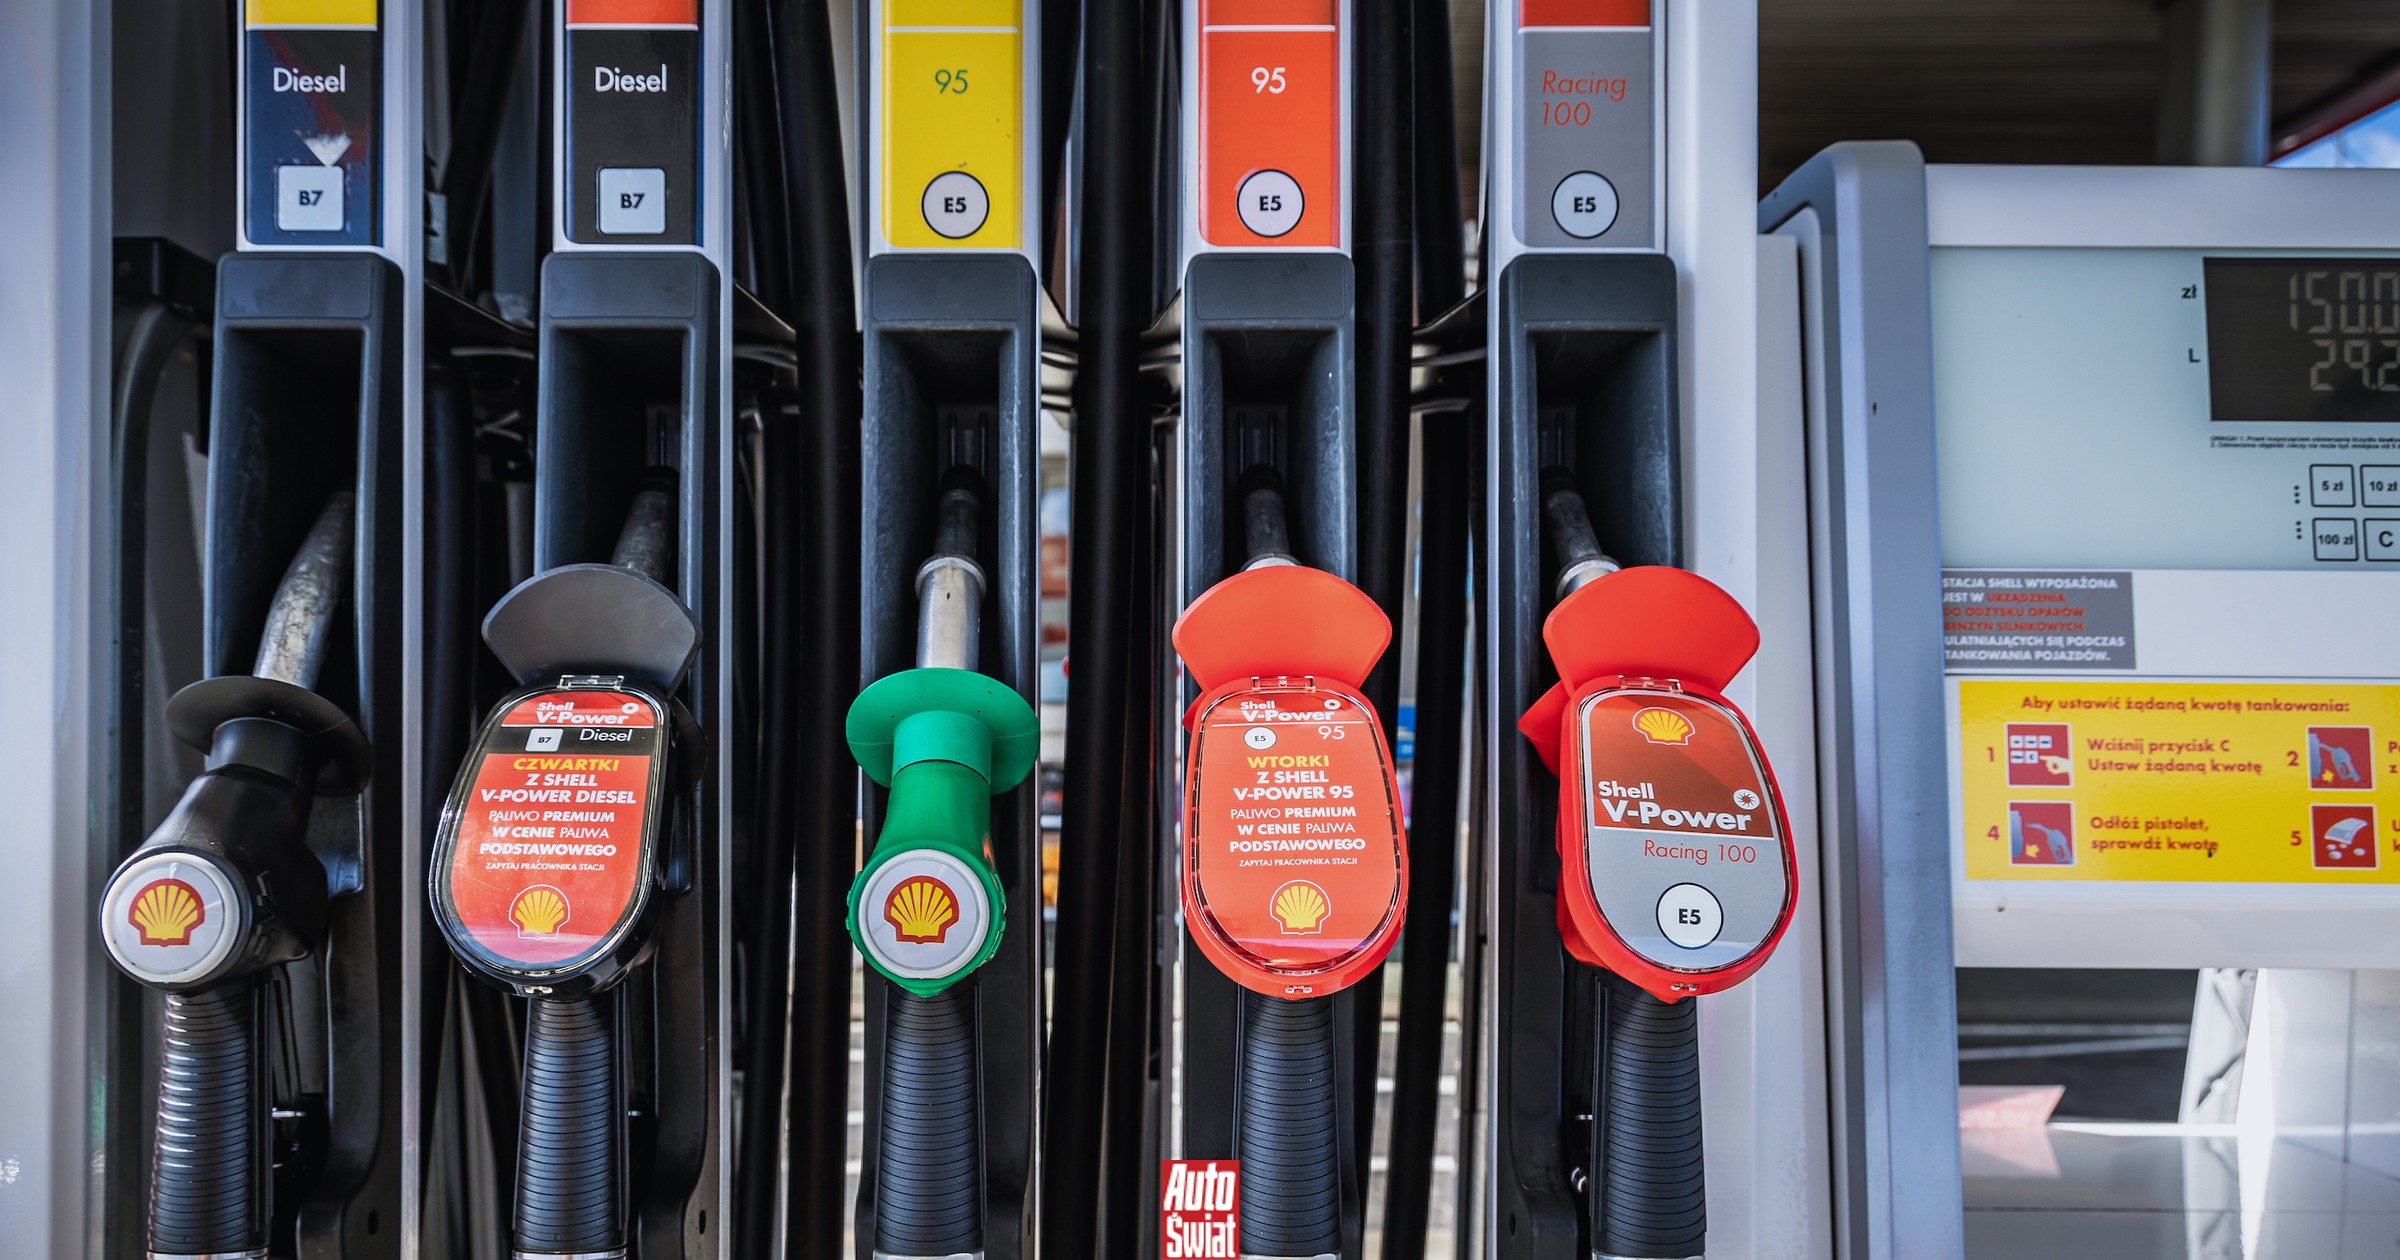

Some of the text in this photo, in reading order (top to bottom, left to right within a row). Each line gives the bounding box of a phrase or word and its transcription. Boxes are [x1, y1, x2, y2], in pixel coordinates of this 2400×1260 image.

[272, 64, 346, 94] Diesel
[594, 64, 668, 93] Diesel
[935, 68, 969, 95] 95
[1251, 67, 1287, 95] 95
[1542, 69, 1627, 102] Racing
[1540, 101, 1591, 127] 100
[297, 189, 324, 207] B7
[619, 192, 645, 210] B7
[944, 196, 967, 214] E5
[1259, 195, 1282, 212] E5
[1573, 196, 1596, 214] E5
[2181, 283, 2197, 300] zł
[2188, 347, 2201, 363] L
[2321, 481, 2330, 491] 5
[2369, 481, 2383, 491] 10
[2318, 534, 2339, 545] 100
[2378, 530, 2394, 548] C
[1942, 576, 2118, 589] STACJA SHELL WYPOSAŻONA
[1942, 593, 1968, 603] JEST
[1969, 593, 1985, 602] W
[1943, 607, 1962, 617] DO
[2046, 637, 2064, 648] SIĘ
[2066, 637, 2126, 647] PODCZAS
[1945, 650, 2032, 660] TANKOWANIA
[537, 701, 574, 711] Shell
[1240, 701, 1275, 710] Shell
[2021, 696, 2350, 714] Aby ustawić żądaną kwotę tankowania:
[536, 711, 628, 725] V-Power
[1241, 709, 1335, 721] V-Power
[579, 728, 633, 743] Diesel
[1317, 725, 1345, 740] 95
[2087, 738, 2230, 755] Wciśnij przycisk C
[1246, 755, 1330, 768] WTORKI
[1986, 747, 1995, 762] 1
[2286, 751, 2299, 766] 2
[513, 758, 620, 772] CZWARTKI
[2088, 758, 2263, 775] Ustaw żądaną kwotę
[2389, 763, 2398, 774] z
[524, 773, 598, 787] Z SHELL
[1256, 771, 1329, 783] Z SHELL
[481, 789, 637, 804] V-POWER DIESEL
[1233, 786, 1354, 801] V-POWER 95
[1598, 780, 1655, 800] Shell
[488, 810, 615, 823] PALIWO PREMIUM
[1230, 806, 1357, 819] PALIWO PREMIUM
[1599, 798, 1753, 832] V-Power
[1237, 823, 1356, 835] W CENIE PALIWA
[2091, 815, 2209, 834] Odłóż pistolet,
[492, 826, 609, 839] W CENIE PALIWA
[1987, 825, 2000, 841] 4
[2290, 831, 2302, 846] 5
[479, 843, 617, 856] PODSTAWOWEGO
[1229, 838, 1367, 853] PODSTAWOWEGO
[1644, 839, 1757, 865] Racing 100
[2091, 836, 2219, 853] sprawdź kwotę
[485, 862, 519, 870] ZAPYTAJ
[578, 863, 605, 871] STACJI
[1239, 857, 1358, 867] ZAPYTAJ PRACOWNIKA STACJI
[1678, 908, 1702, 925] E5
